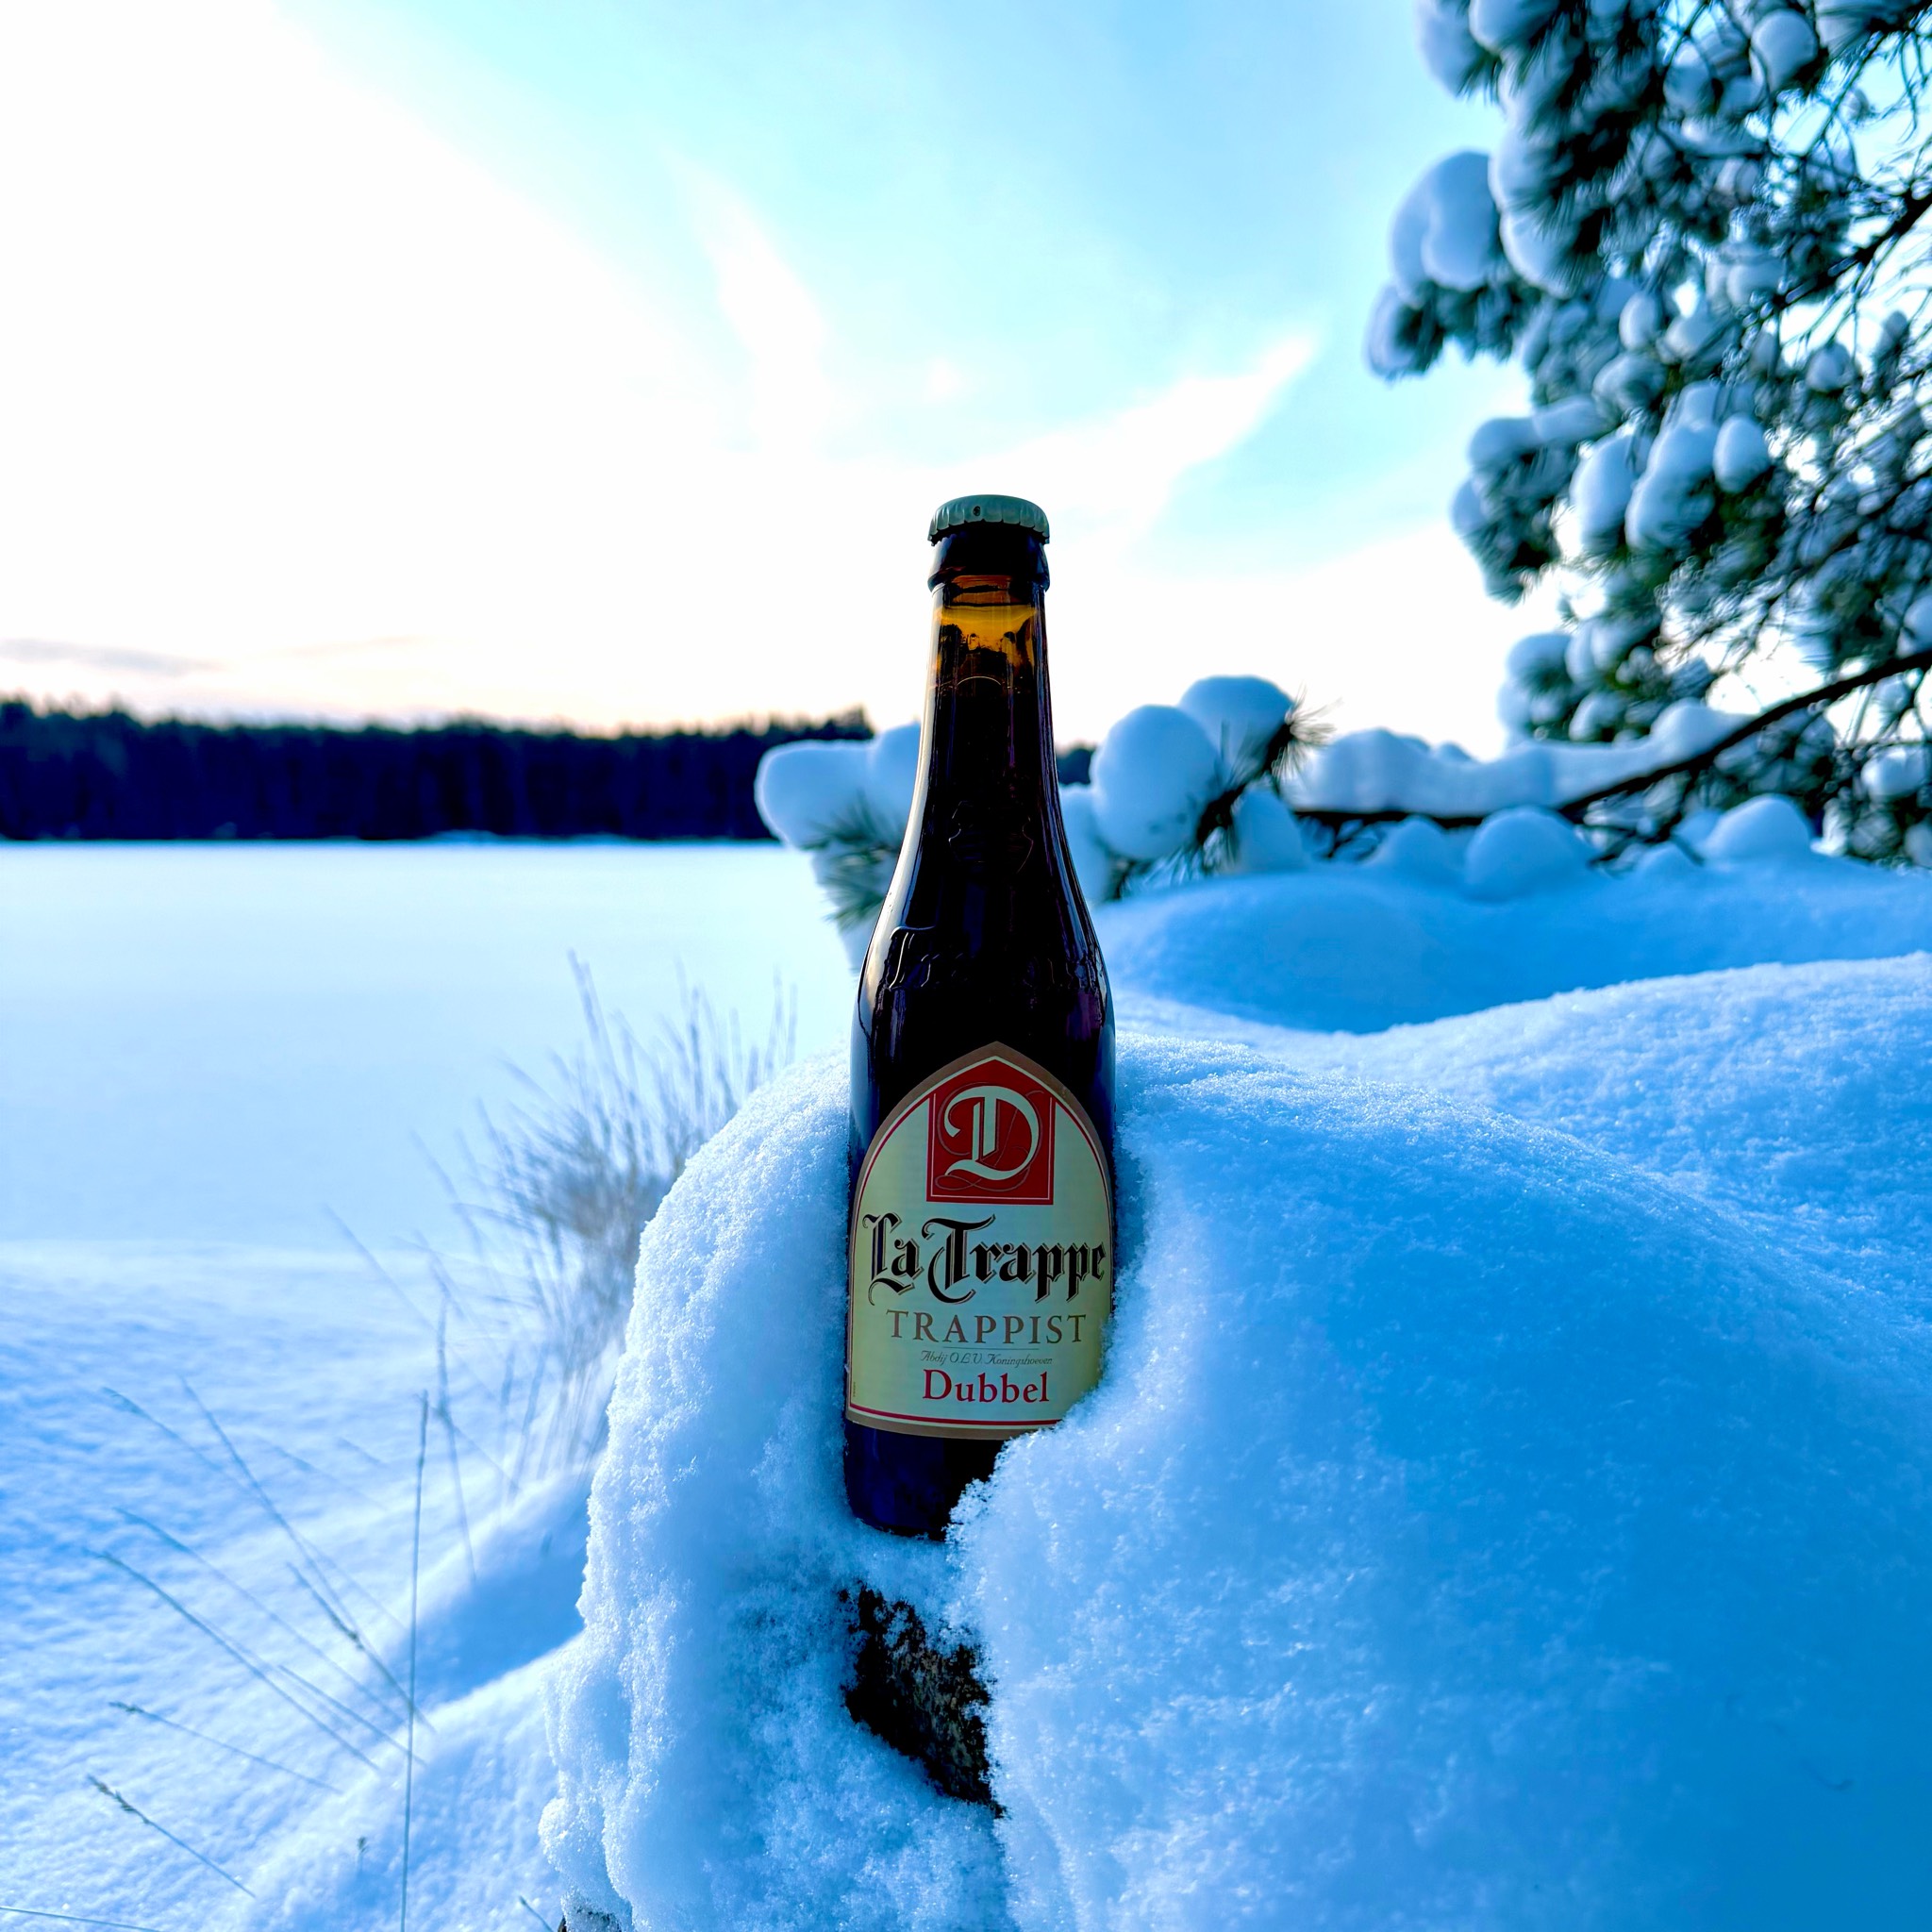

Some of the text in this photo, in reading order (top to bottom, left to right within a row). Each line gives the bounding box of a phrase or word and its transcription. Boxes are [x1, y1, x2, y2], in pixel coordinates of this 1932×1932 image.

[941, 1085, 1040, 1181] D
[862, 1212, 1106, 1306] La Trappe
[886, 1309, 1087, 1344] TRAPPIST
[921, 1350, 947, 1366] Abdij
[984, 1353, 1053, 1368] Koningshoeven
[923, 1369, 1050, 1404] Dubbel
